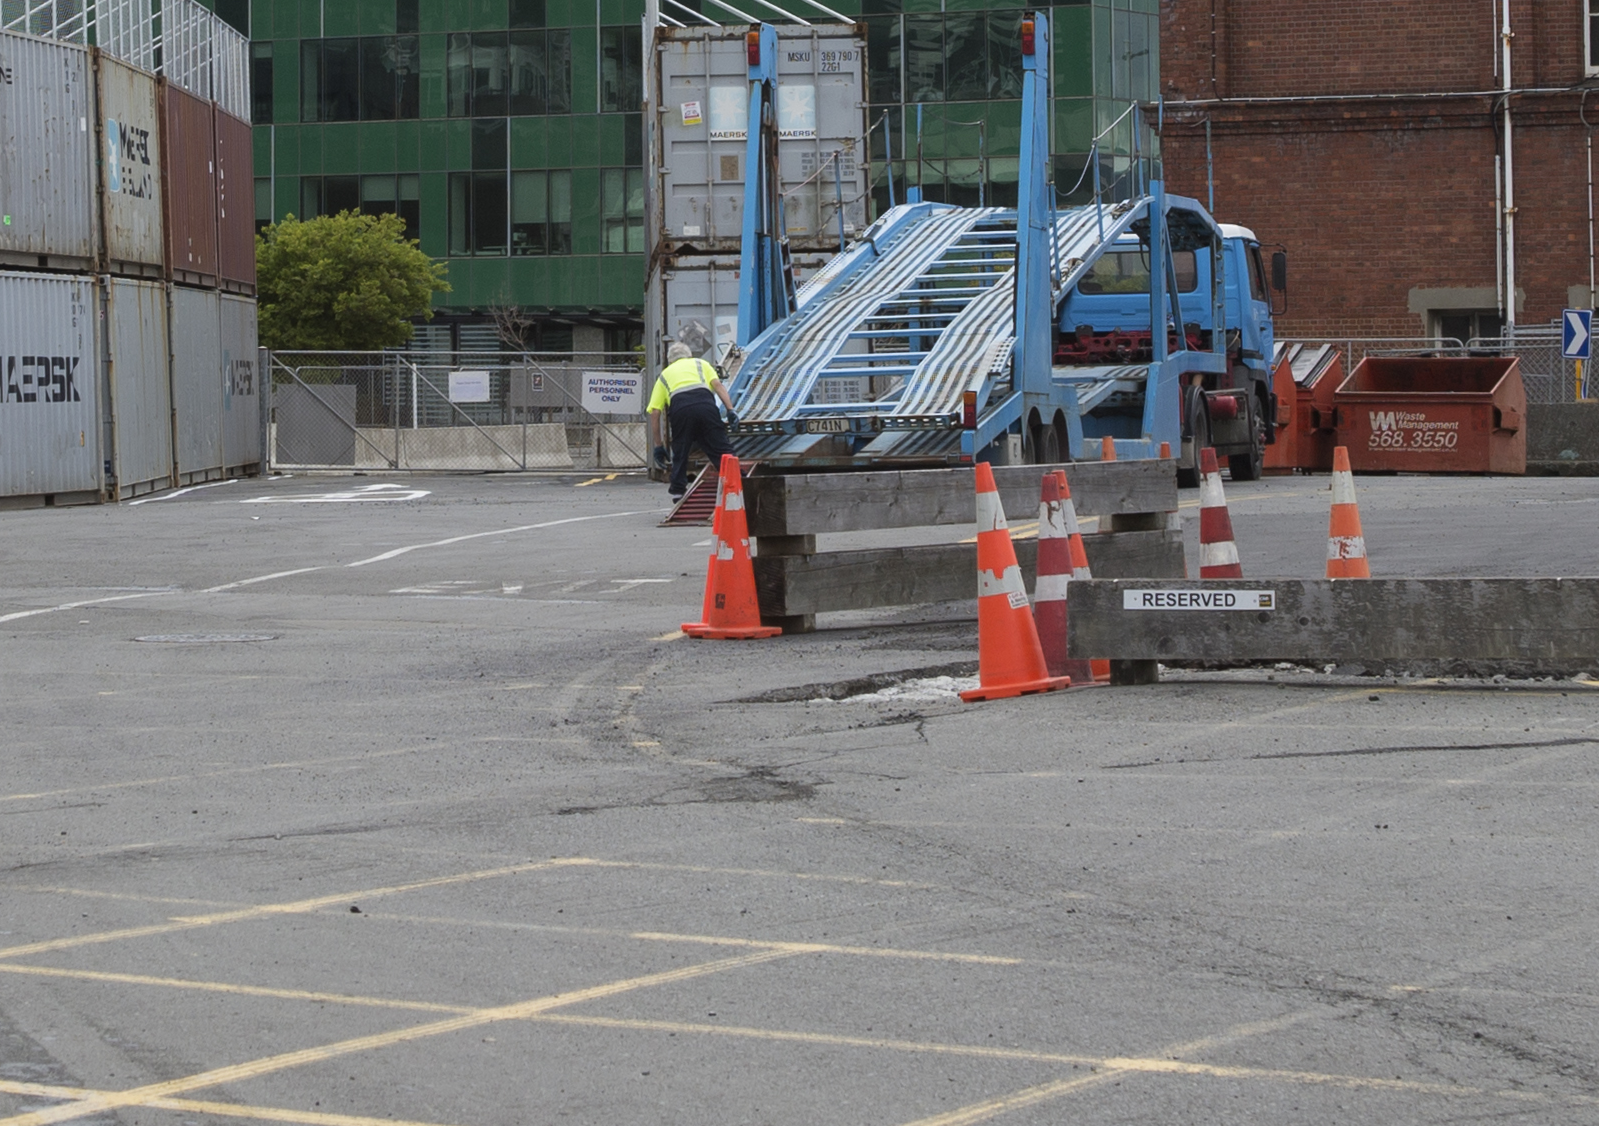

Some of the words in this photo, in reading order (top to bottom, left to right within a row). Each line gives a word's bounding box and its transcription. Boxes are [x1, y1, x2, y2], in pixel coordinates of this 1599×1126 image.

[788, 52, 810, 62] MSKU
[821, 51, 836, 61] 369
[838, 51, 852, 61] 790
[821, 62, 841, 71] 22G1
[710, 131, 747, 139] MAERSK
[780, 130, 817, 138] MAERSK
[588, 378, 637, 387] AUTHORISED
[589, 386, 635, 395] PERSONNEL
[601, 395, 621, 403] ONLY
[1396, 411, 1426, 421] Waste
[807, 420, 842, 431] C741N
[1398, 420, 1459, 431] Management
[1142, 592, 1236, 607] RESERVED
